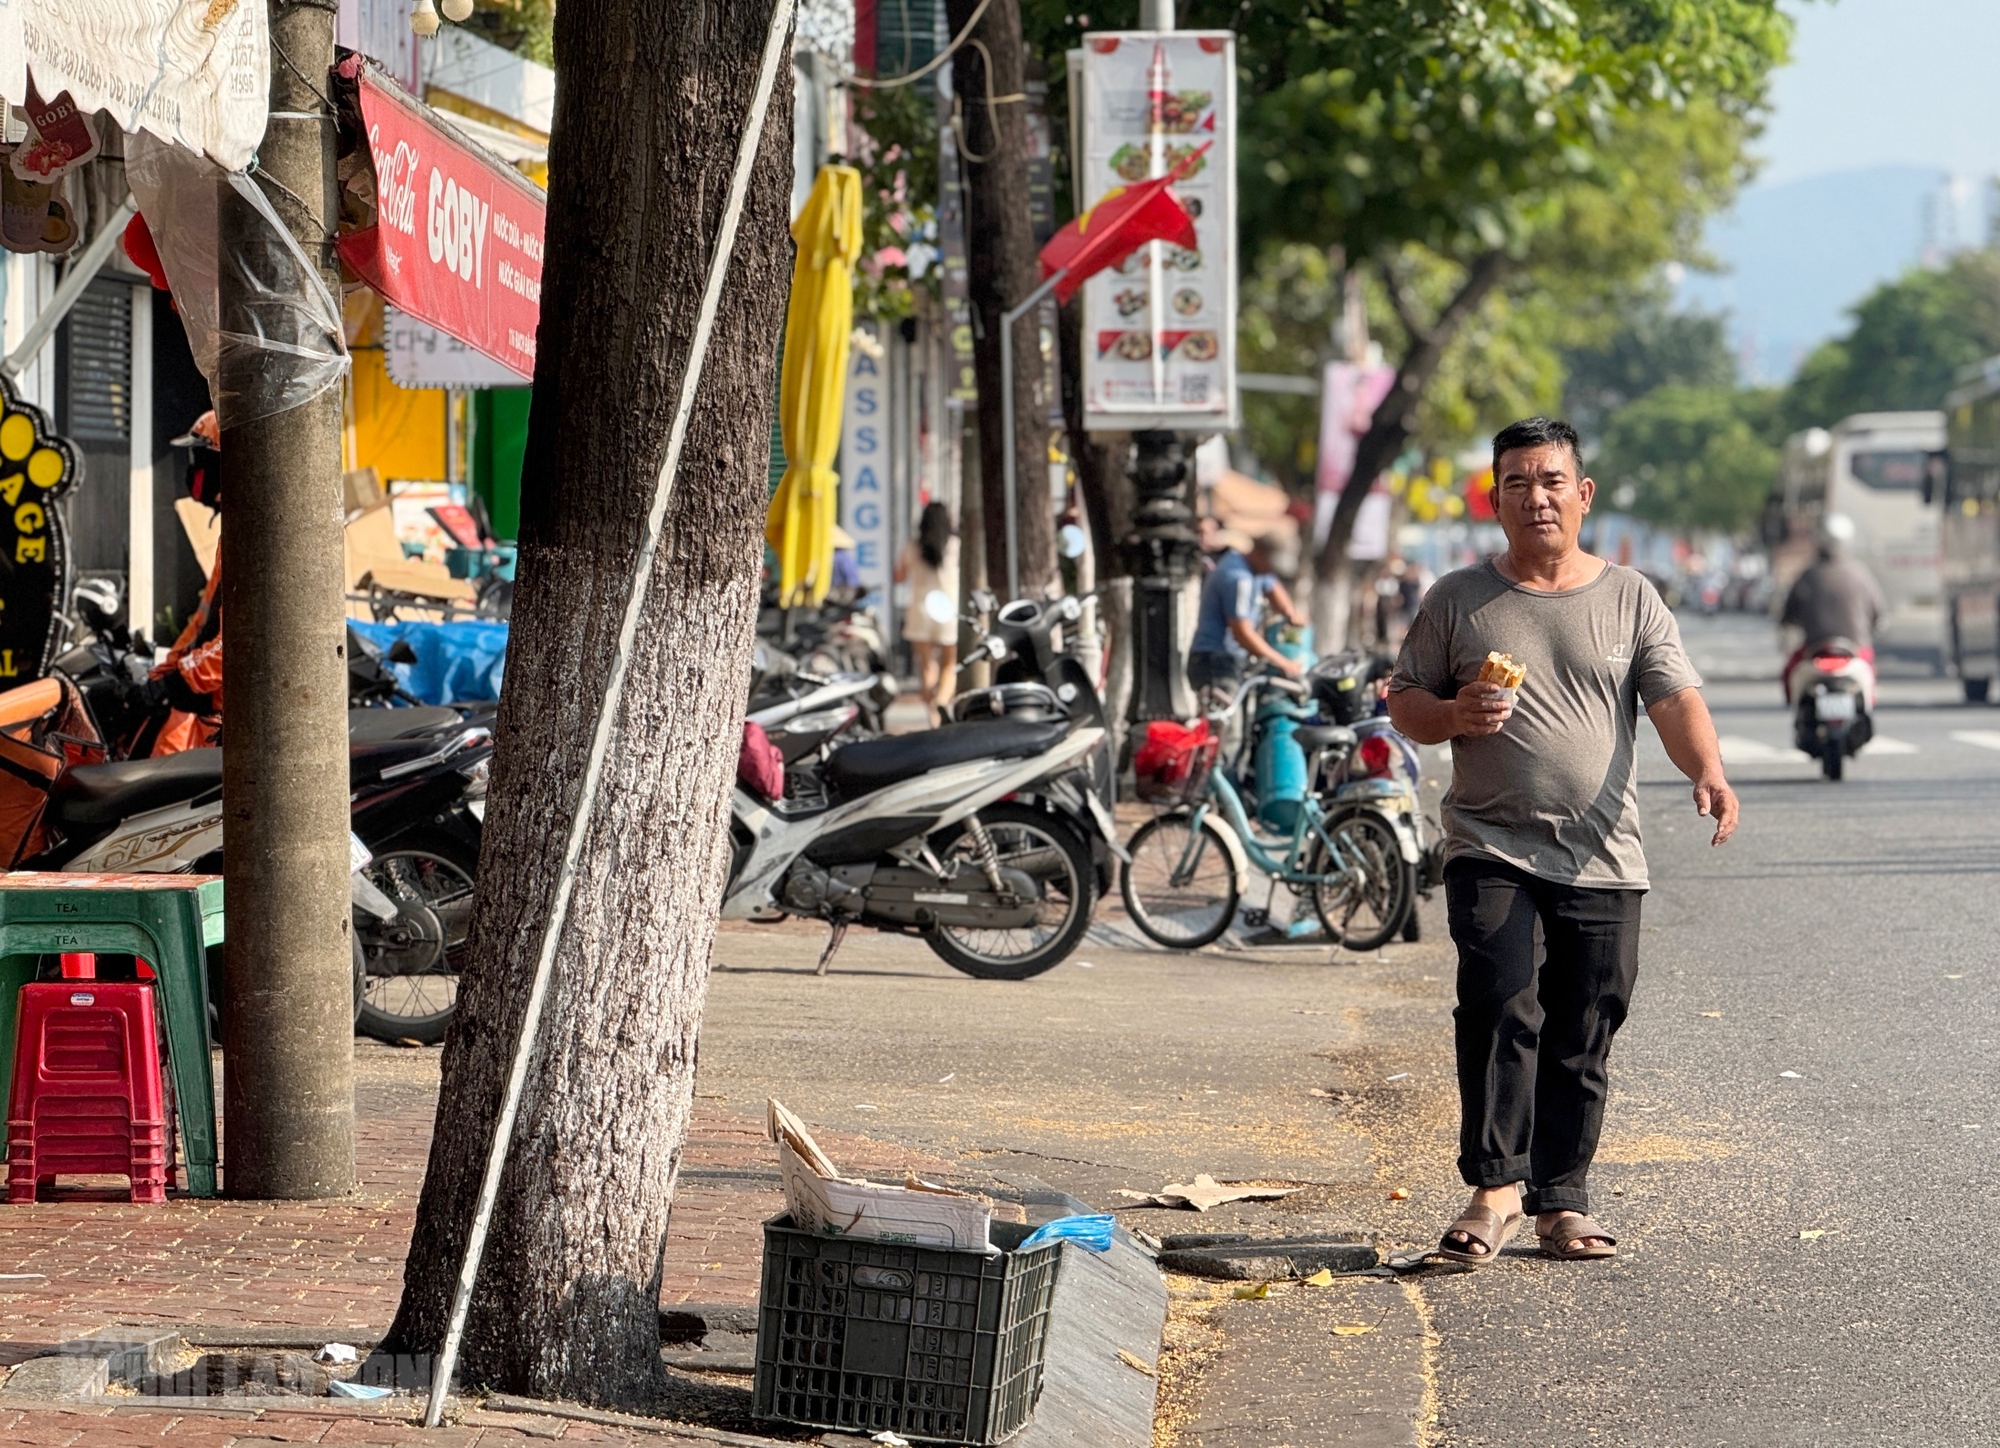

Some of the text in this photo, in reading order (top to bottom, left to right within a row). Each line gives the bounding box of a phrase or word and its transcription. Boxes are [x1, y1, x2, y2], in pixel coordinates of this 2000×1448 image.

[36, 103, 75, 127] GOBY
[427, 166, 489, 290] GOBY
[853, 353, 882, 568] ASSAGE
[54, 903, 78, 913] TEA
[54, 935, 78, 945] TEA
